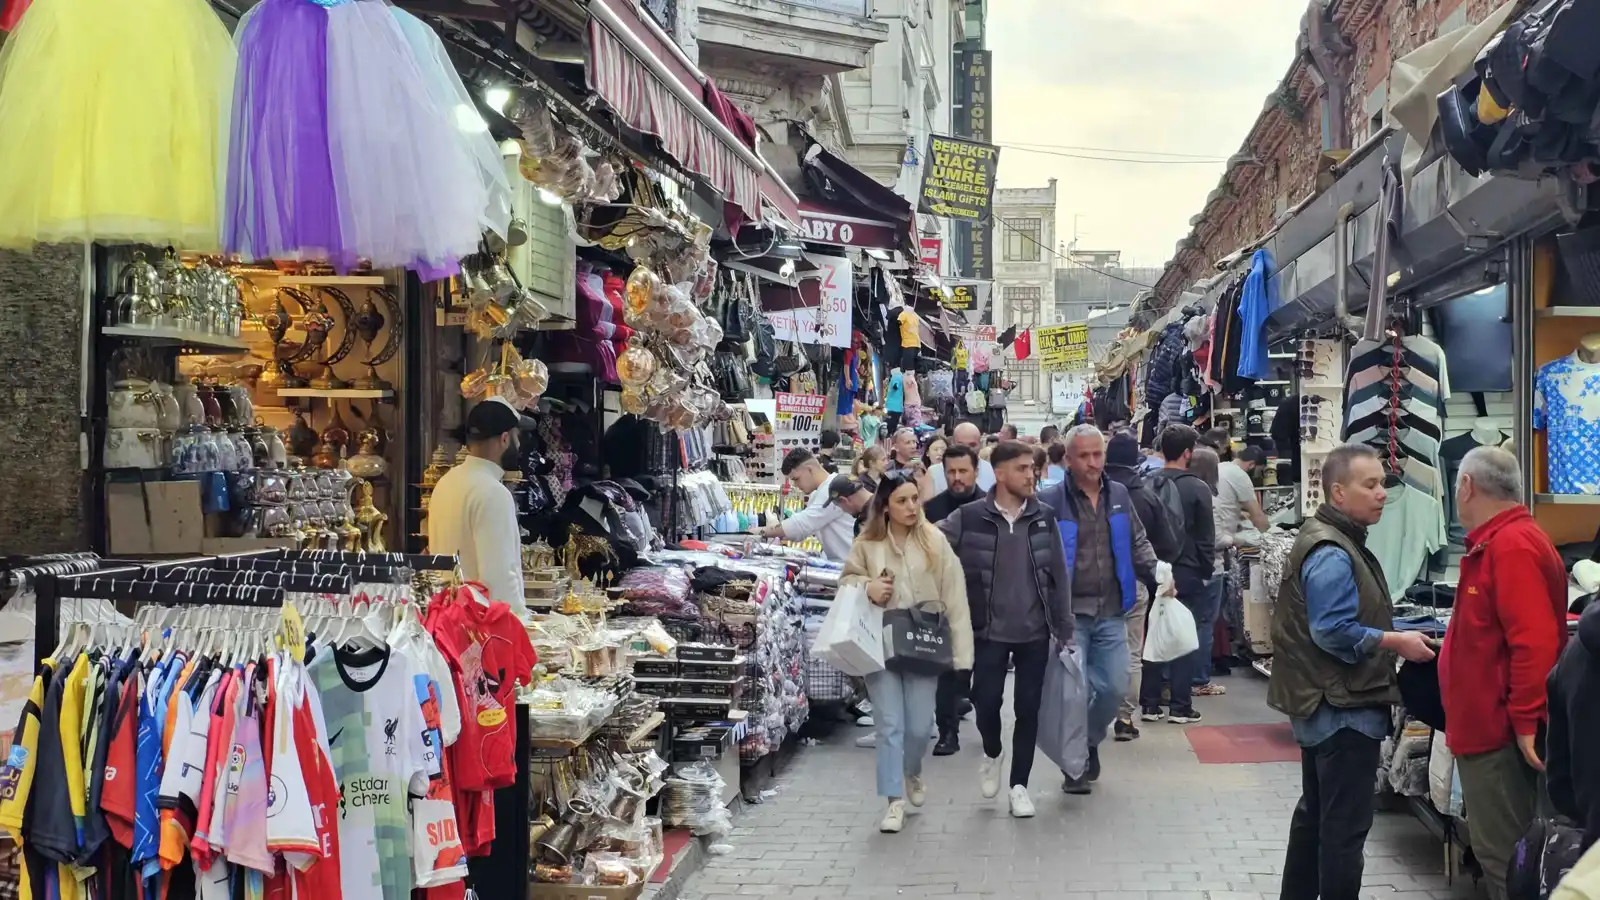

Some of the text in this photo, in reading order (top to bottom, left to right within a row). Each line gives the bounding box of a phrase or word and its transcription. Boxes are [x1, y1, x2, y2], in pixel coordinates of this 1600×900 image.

[933, 139, 995, 160] BEREKET
[935, 152, 977, 171] HAC
[932, 165, 986, 186] UMRE
[929, 286, 969, 297] HC
[778, 394, 825, 407] GÖZLÜK
[792, 414, 812, 432] 100
[811, 424, 819, 432] TL
